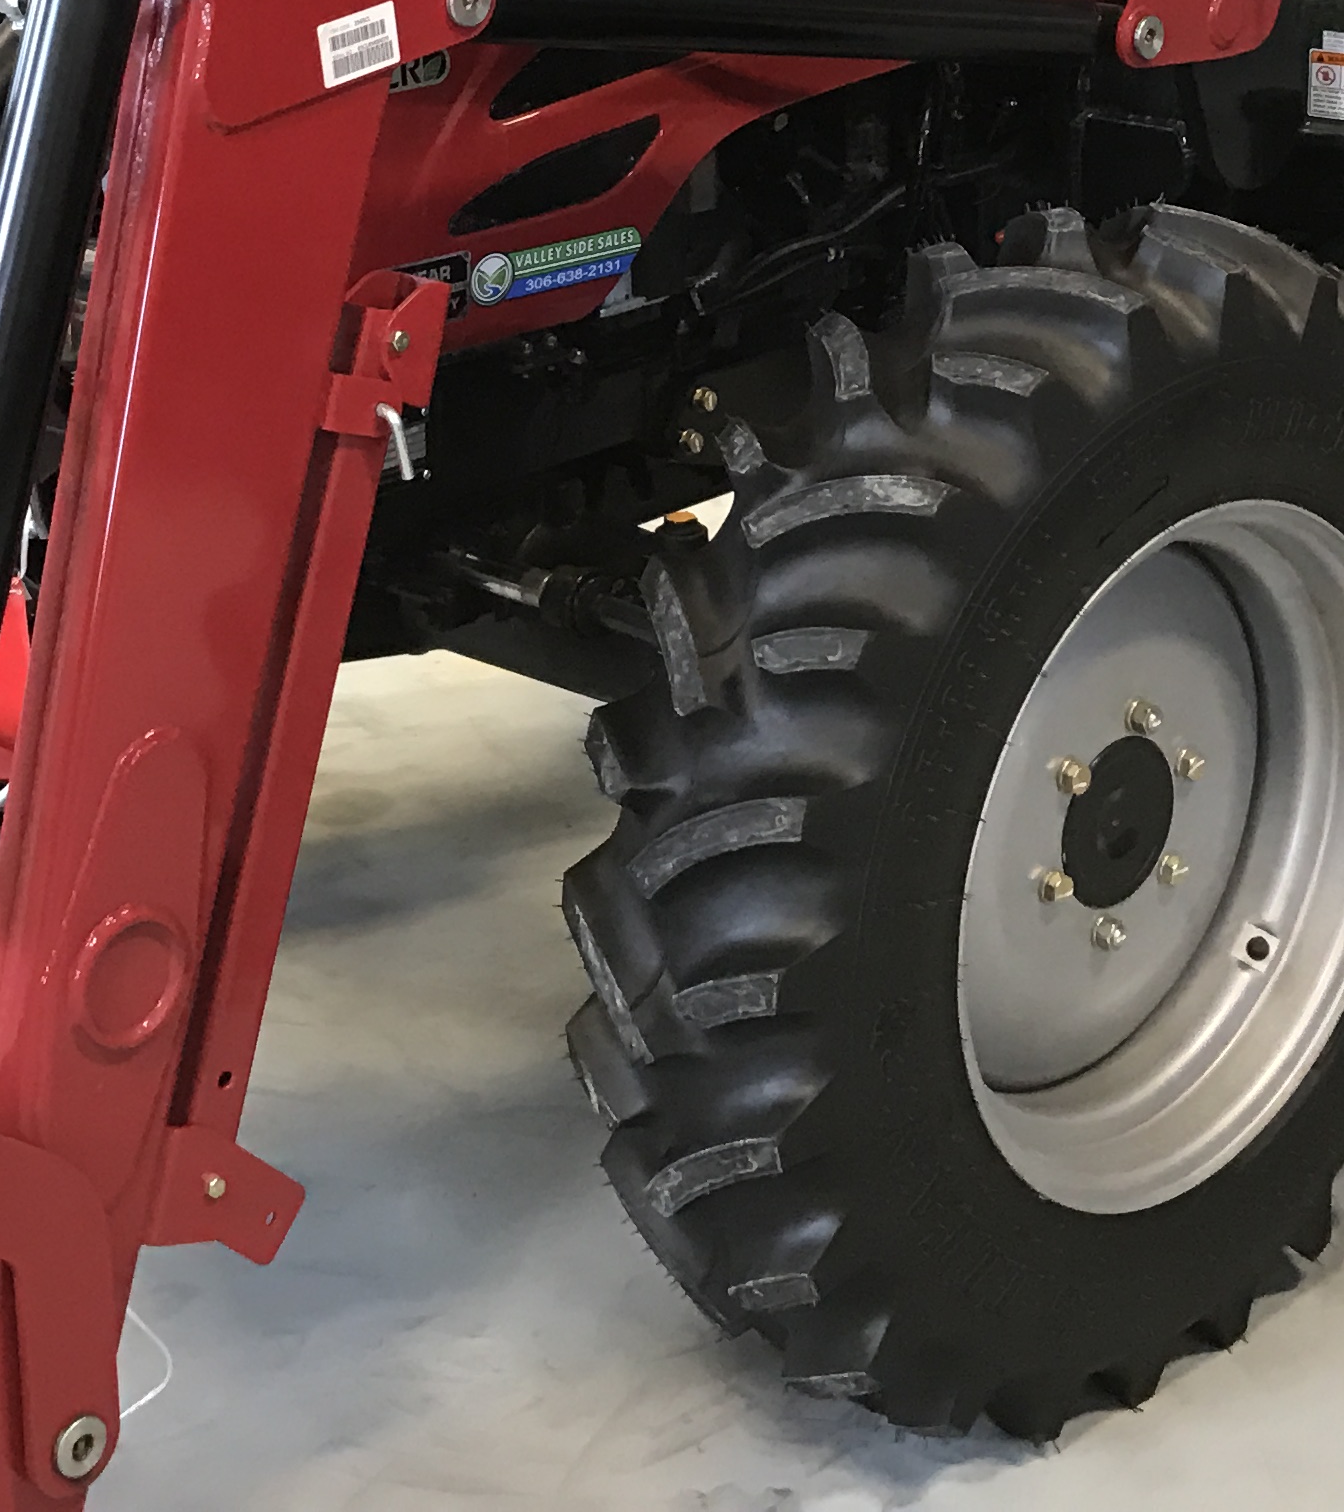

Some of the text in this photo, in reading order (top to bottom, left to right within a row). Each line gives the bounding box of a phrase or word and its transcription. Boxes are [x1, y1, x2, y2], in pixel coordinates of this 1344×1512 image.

[515, 229, 635, 269] VALLEY SIDE SALES
[525, 259, 622, 292] 306-638-2131
